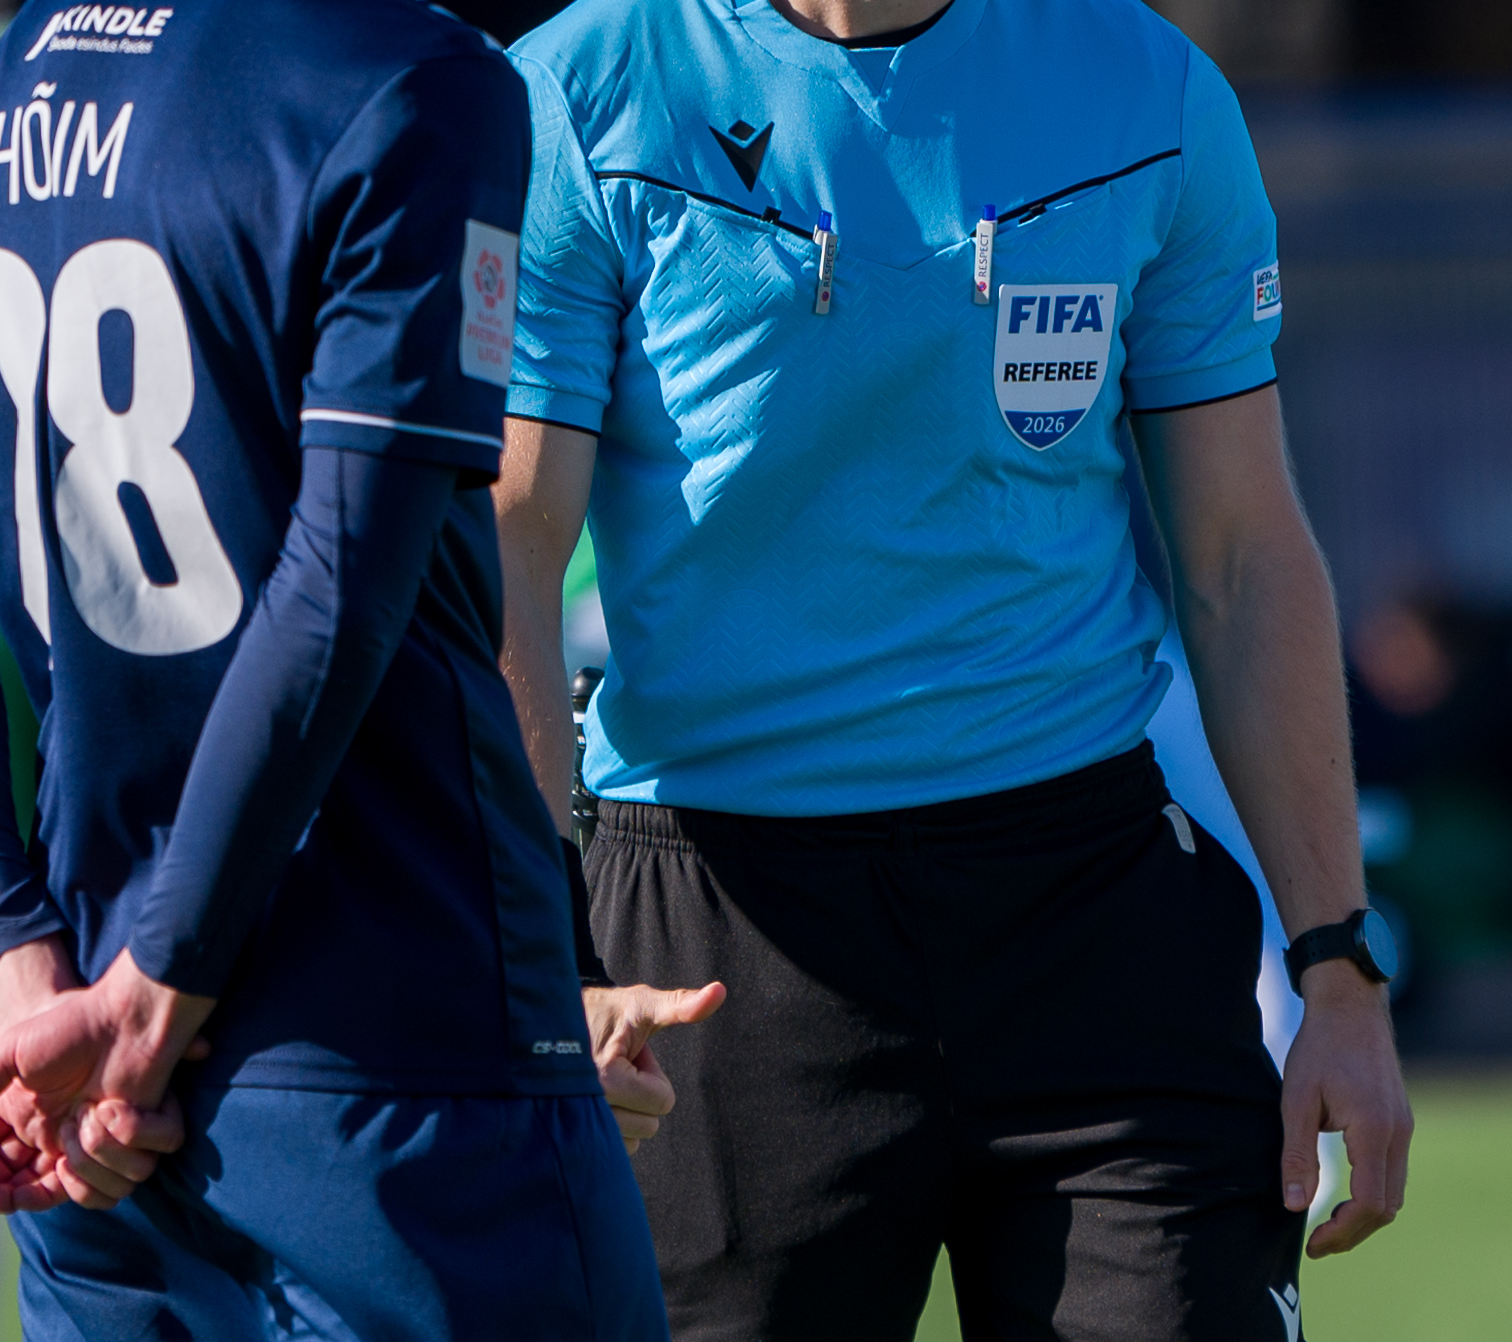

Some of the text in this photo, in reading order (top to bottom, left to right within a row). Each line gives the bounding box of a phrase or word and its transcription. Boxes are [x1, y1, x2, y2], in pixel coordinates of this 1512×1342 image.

[28, 4, 174, 57] KINDLE
[823, 242, 835, 288] RESPECT
[978, 233, 989, 277] RESPECT
[1008, 295, 1103, 334] FIFA
[1003, 361, 1098, 382] REFEREE
[1022, 416, 1065, 433] 2026
